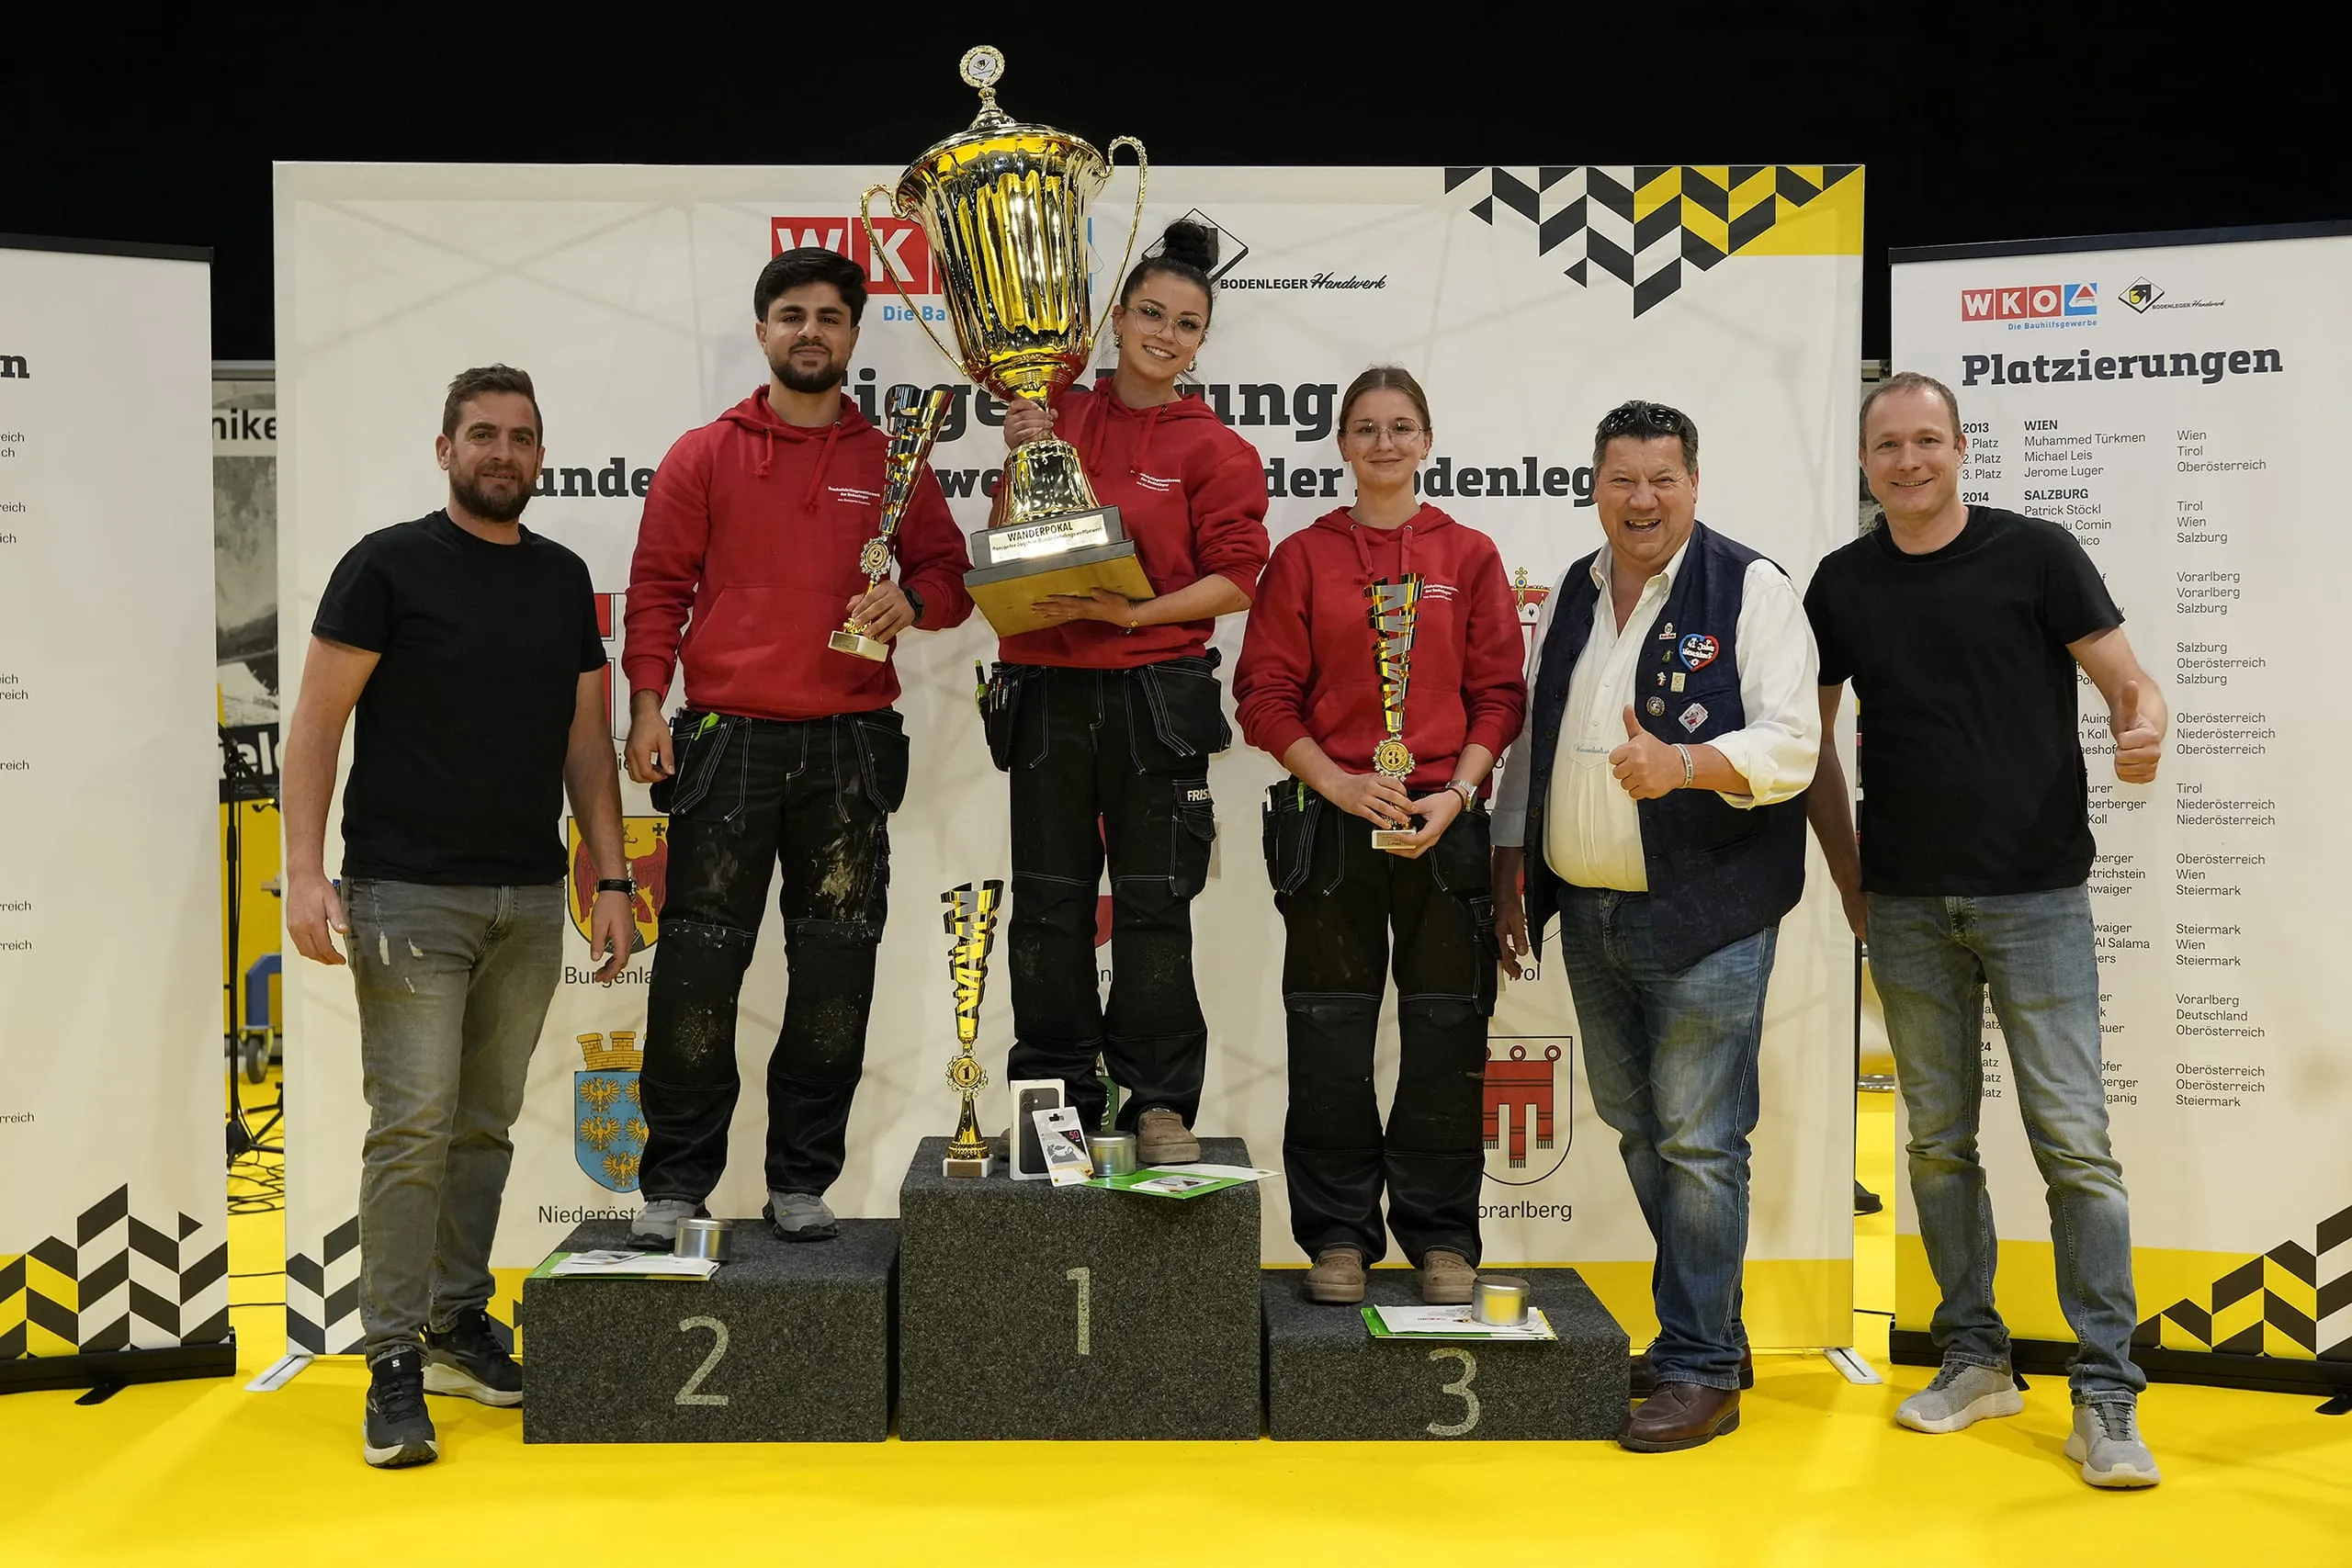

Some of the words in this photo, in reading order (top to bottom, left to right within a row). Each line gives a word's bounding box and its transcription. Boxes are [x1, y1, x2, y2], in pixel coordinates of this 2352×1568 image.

[1220, 278, 1309, 289] BODENLEGER
[1310, 272, 1386, 289] Handwerk
[1964, 289, 2058, 317] WKO
[2151, 302, 2190, 310] BODENLEGER
[2007, 322, 2022, 331] Die
[2024, 319, 2098, 332] Bauhilfsgewerbe
[1962, 348, 2284, 388] Platzierungen
[1962, 422, 1990, 435] 2013
[2024, 420, 2057, 431] WIEN
[1973, 438, 1998, 448] Platz
[2025, 434, 2091, 446] Muhammed
[2095, 434, 2145, 444] Türkmen
[2177, 430, 2206, 440] Wien
[2177, 446, 2202, 456] Tirol
[1962, 455, 1972, 465] 2.
[1975, 454, 2001, 463] Platz
[2025, 451, 2067, 461] Michael
[2071, 450, 2092, 460] Leis
[2177, 459, 2266, 472] Oberösterreich
[1962, 469, 1973, 479] 3.
[1975, 469, 2001, 479] Platz
[2024, 468, 2067, 477] Jerome
[2072, 466, 2104, 478] Luger
[1962, 491, 1990, 502] 2014
[2025, 489, 2088, 500] SALZBURG
[2023, 504, 2064, 517] Patrick
[2067, 504, 2100, 514] Stöckl
[2177, 501, 2202, 511] Tirol
[2075, 519, 2111, 530] Comin
[2177, 516, 2206, 526] Wien
[1007, 521, 1073, 542] WANDERPOKAL
[2177, 533, 2227, 544] Salzburg
[2177, 571, 2240, 583] Vorarlberg
[2177, 587, 2240, 599] Vorarlberg
[2177, 604, 2227, 615] Salzburg
[2177, 642, 2227, 654] Salzburg
[2177, 658, 2266, 668] Oberösterreich
[2177, 673, 2227, 685] Salzburg
[2177, 713, 2265, 723] Oberösterreich
[2088, 728, 2107, 739] Koll
[2177, 728, 2275, 739] Niederösterreich
[2177, 744, 2265, 754] Oberösterreich
[1187, 788, 1211, 802] FRIS
[2087, 785, 2113, 794] urer
[2177, 784, 2201, 794] Tirol
[2087, 798, 2147, 811] berberger
[2177, 799, 2275, 809] Niederösterreich
[2177, 815, 2275, 825] Niederösterreich
[2177, 853, 2265, 864] Oberösterreich
[2177, 869, 2205, 879] Wien
[2177, 885, 2241, 895] Steiermark
[2095, 922, 2132, 935] waiger
[2177, 923, 2241, 934] Steiermark
[2109, 938, 2150, 949] Salama
[2176, 940, 2205, 950] Wien
[2177, 954, 2241, 965] Steiermark
[2176, 994, 2239, 1008] Vorarlberg
[2177, 1007, 2247, 1021] Deutschland
[2177, 1024, 2265, 1037] Oberösterreich
[2177, 1064, 2265, 1076] Oberösterreich
[2177, 1079, 2265, 1091] Oberösterreich
[2106, 1093, 2137, 1105] ganig
[2176, 1094, 2241, 1106] Steiermark
[1069, 1130, 1080, 1140] 50
[1476, 1201, 1574, 1224] orarlberg
[1066, 1267, 1091, 1355] 1
[673, 1315, 729, 1406] 2
[1426, 1347, 1481, 1438] 3
